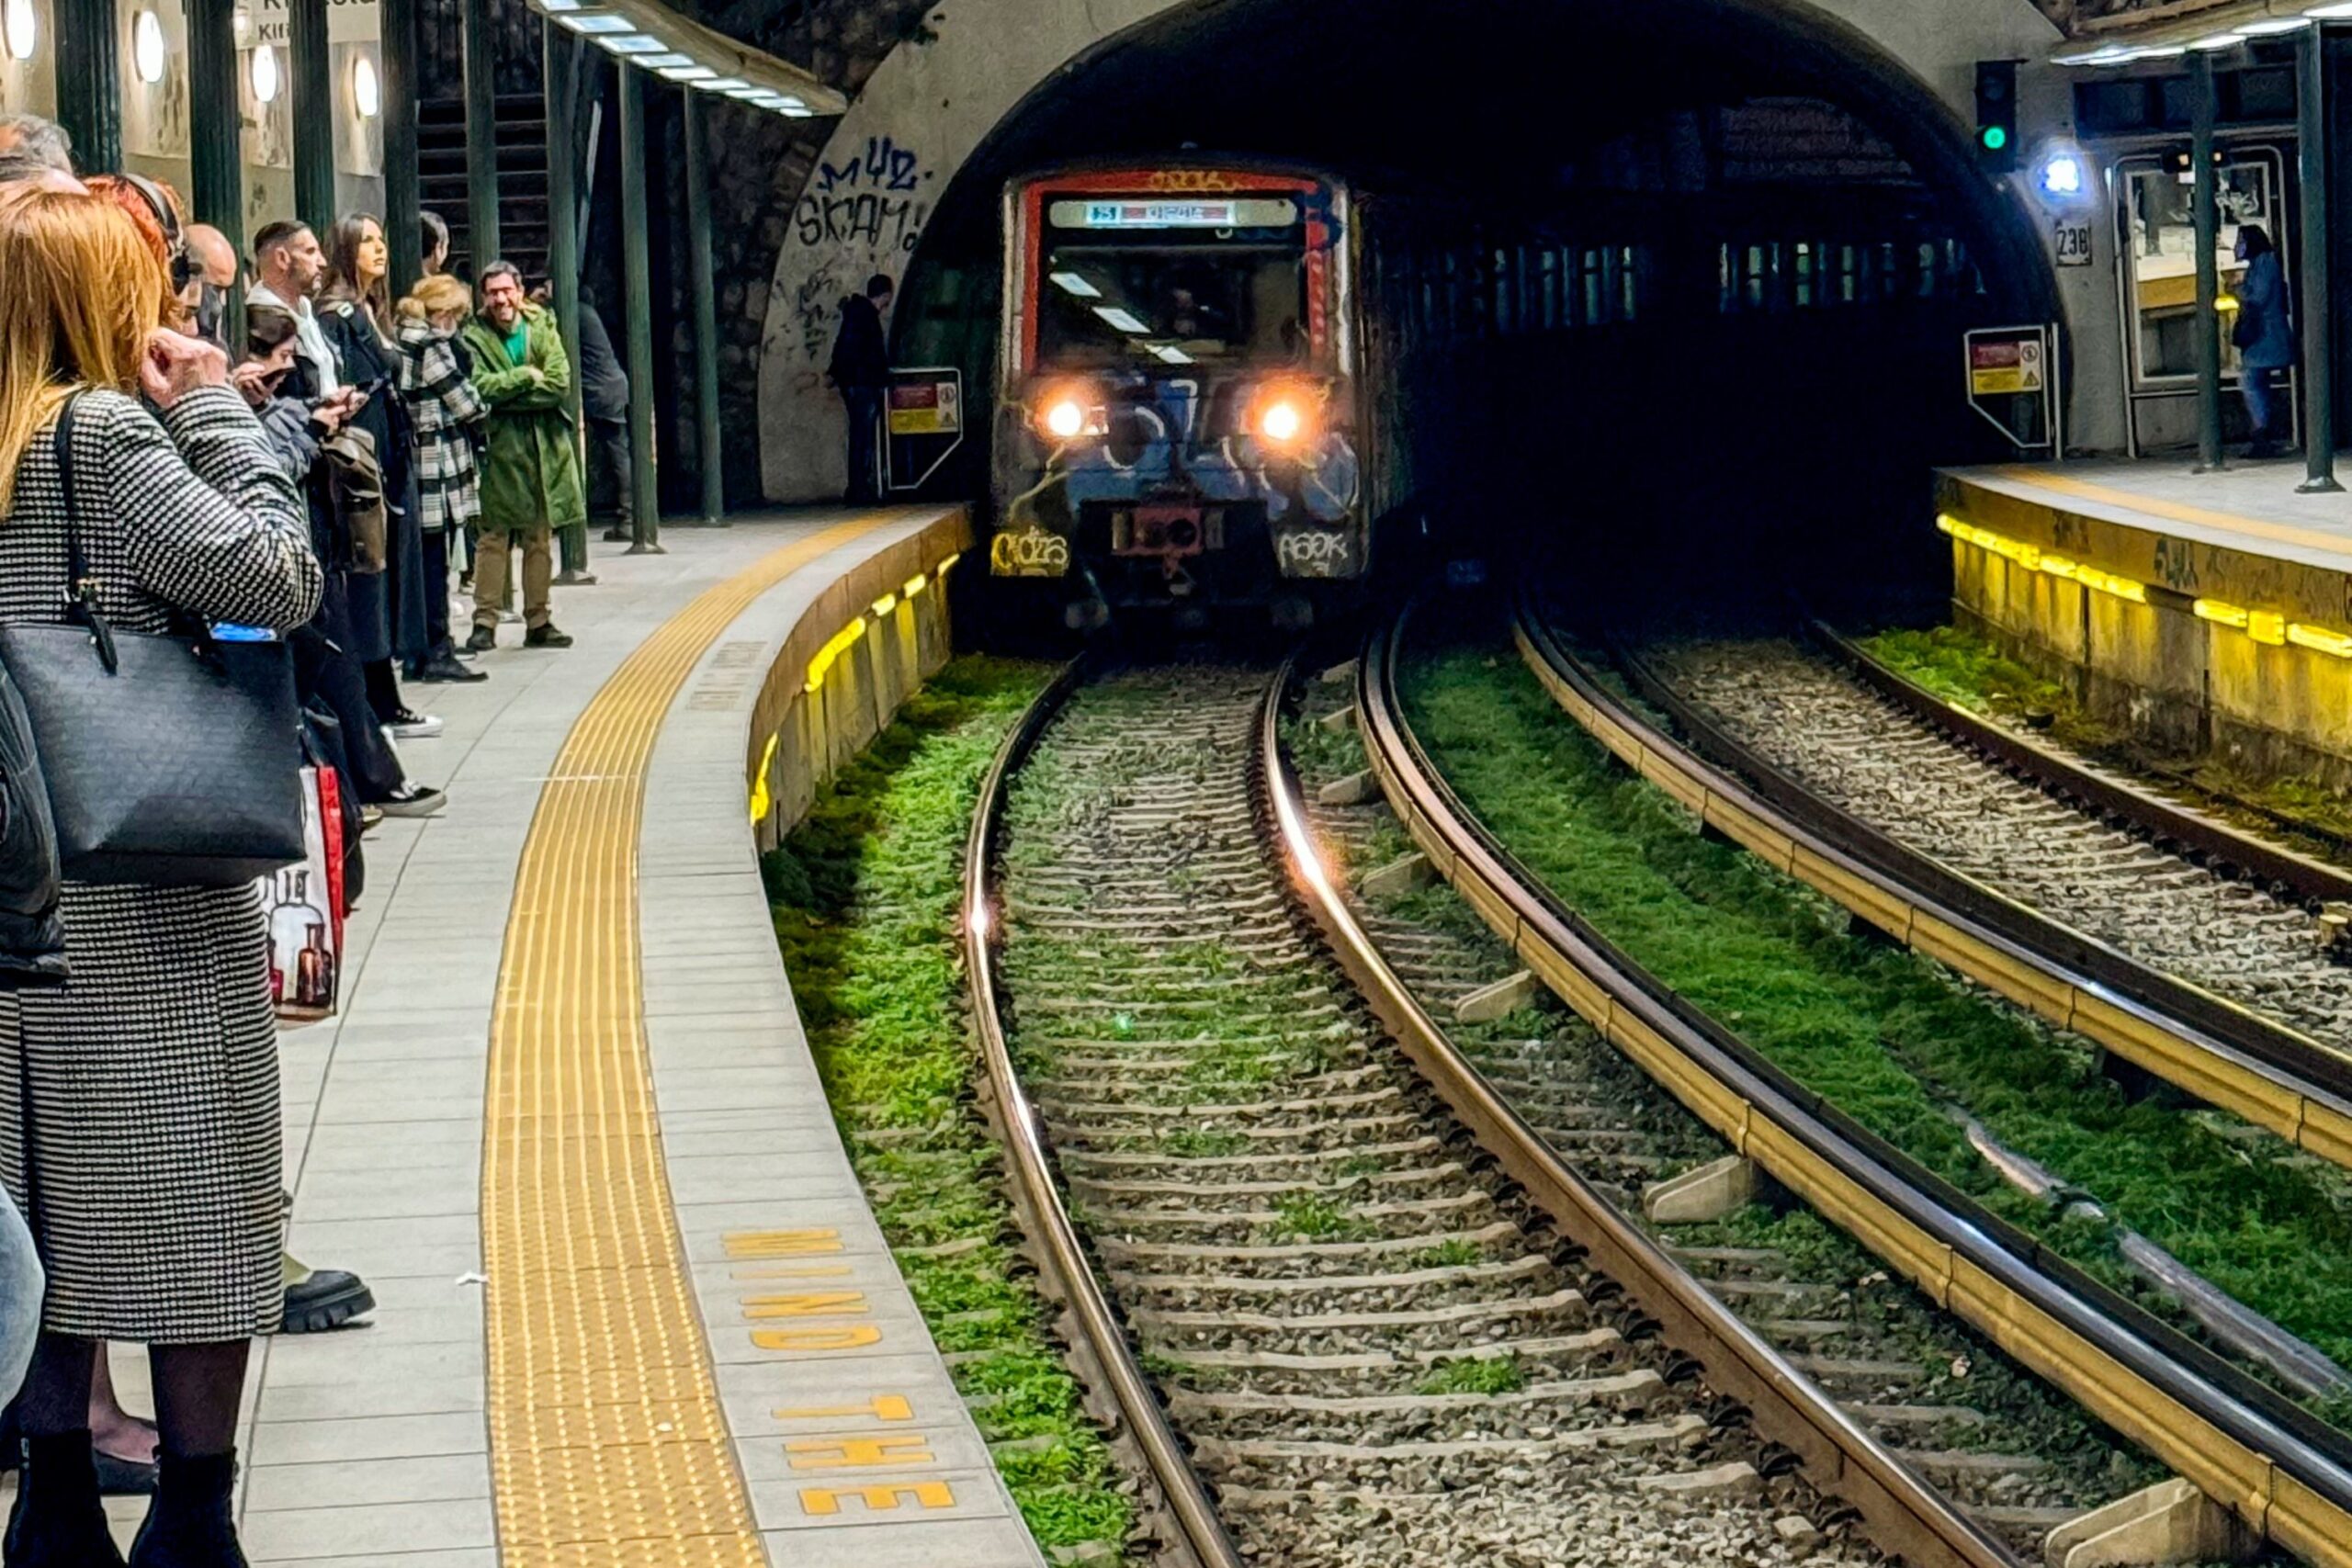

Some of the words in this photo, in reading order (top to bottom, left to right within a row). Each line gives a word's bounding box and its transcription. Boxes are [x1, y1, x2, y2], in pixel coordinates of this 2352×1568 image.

[2057, 227, 2088, 255] 238
[721, 1228, 883, 1350] MIND
[771, 1394, 956, 1516] THE
